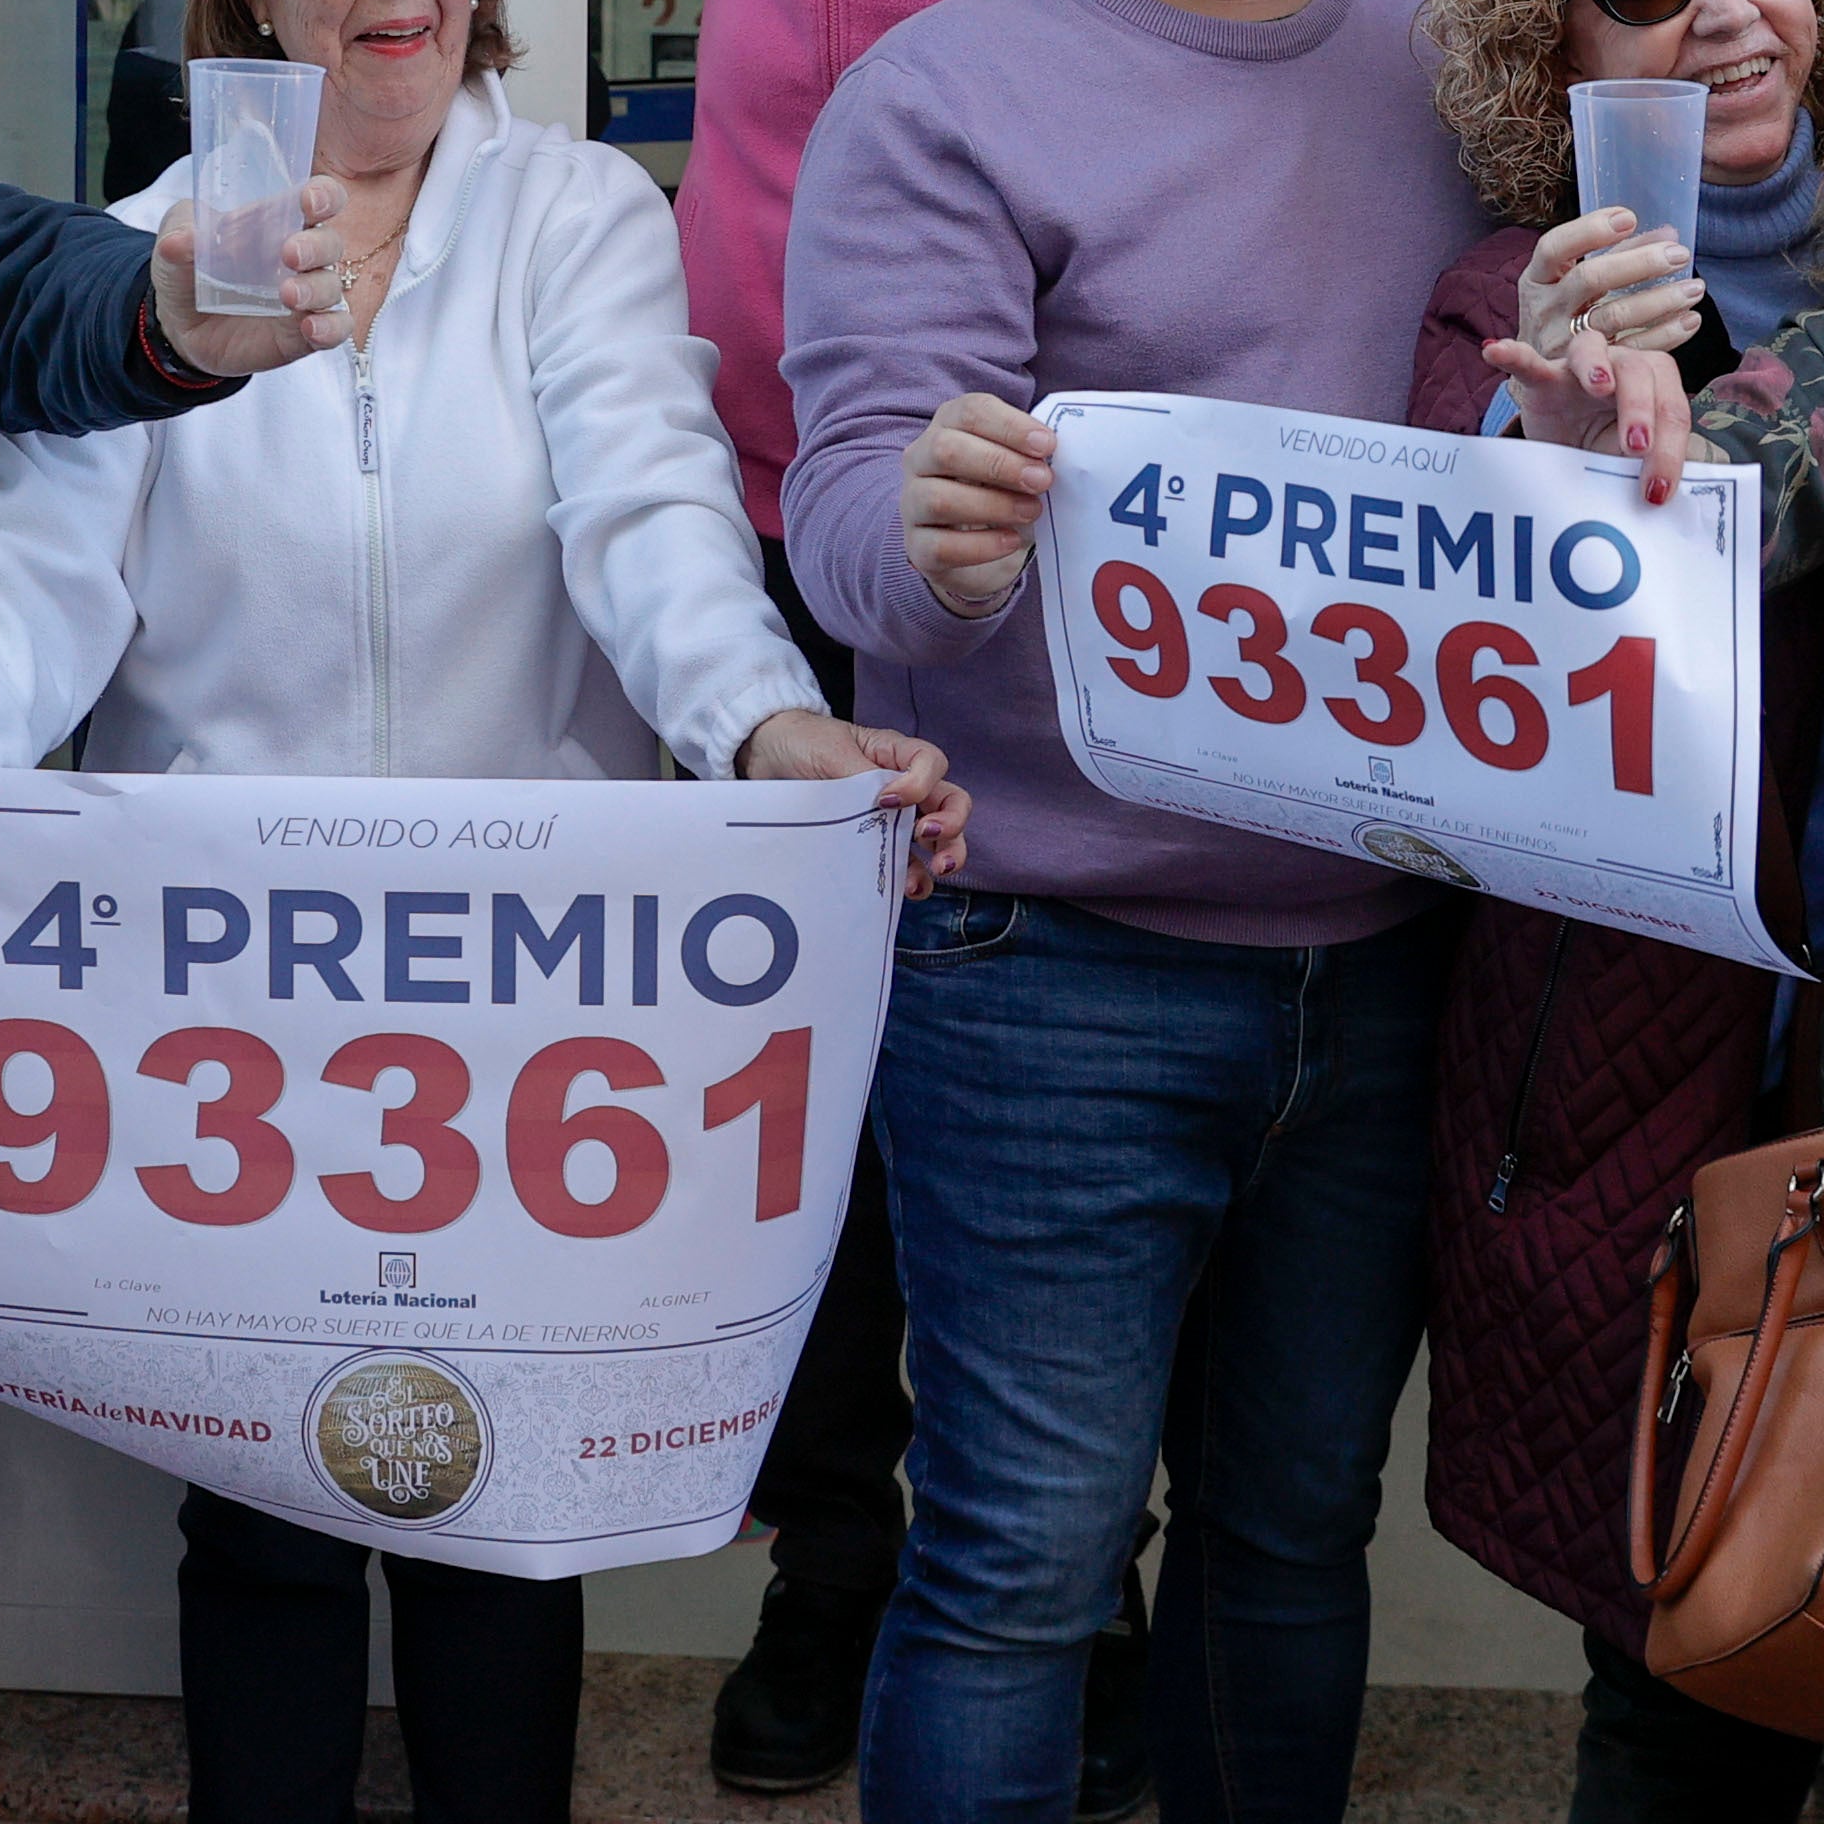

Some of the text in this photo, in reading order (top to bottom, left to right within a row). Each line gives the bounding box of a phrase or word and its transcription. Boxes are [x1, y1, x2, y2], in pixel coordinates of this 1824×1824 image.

[1280, 426, 1461, 475] VENDIDO AQUÍ
[1208, 473, 1642, 611] PREMIO
[1090, 559, 1658, 798] 93361
[1233, 770, 1255, 786] NO
[1257, 776, 1286, 792] HAY
[1288, 782, 1339, 806] MAYOR
[1455, 820, 1474, 835] DE
[1334, 775, 1435, 808] Lotería Nacional
[255, 812, 561, 853] VENDIDO AQUÍ
[162, 885, 801, 1007] PREMIO
[93, 1277, 162, 1294] La Clave
[319, 1289, 477, 1310] Lotería Nacional
[639, 1290, 713, 1309] ALGINET
[146, 1306, 661, 1343] NO HAY MAYOR SUERTE QUE LA DE TENERNOS
[342, 1402, 455, 1447] SORTEO
[370, 1430, 453, 1464] QUE NOS
[578, 1389, 781, 1460] 22 DICIEMBRE
[359, 1455, 432, 1504] UNE
